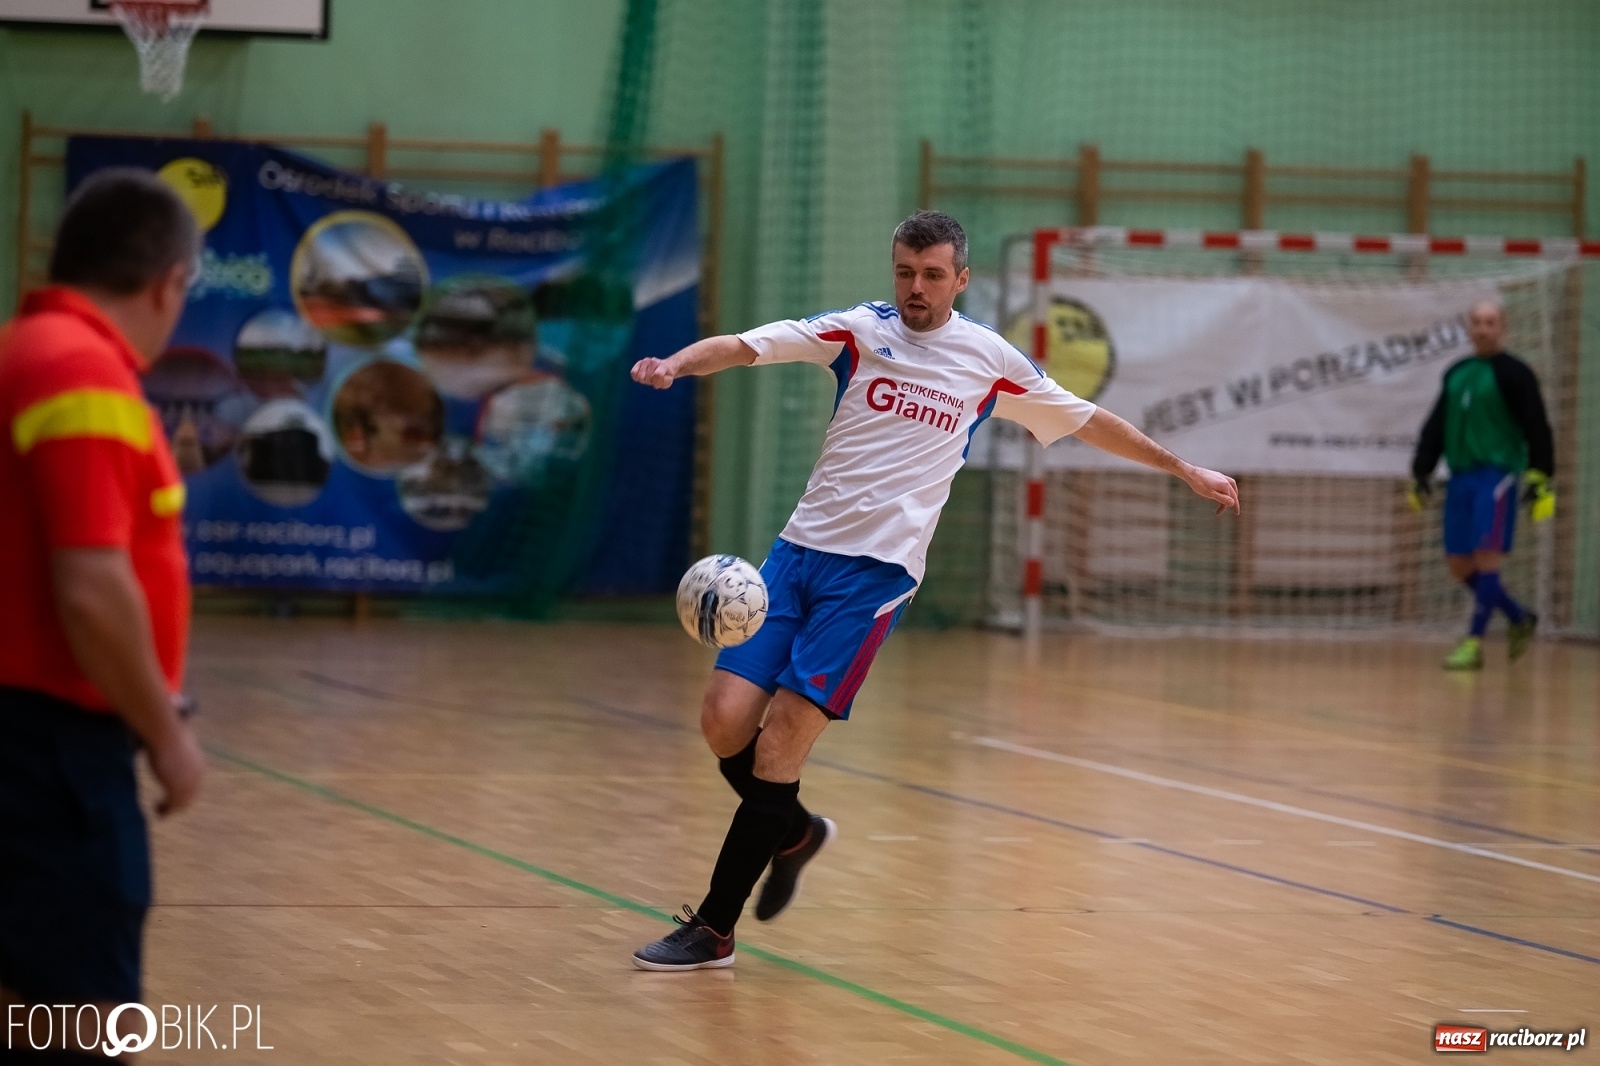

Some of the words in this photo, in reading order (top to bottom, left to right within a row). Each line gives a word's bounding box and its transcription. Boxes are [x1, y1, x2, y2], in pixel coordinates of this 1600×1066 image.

[866, 377, 962, 434] Gianni
[901, 382, 964, 411] CUKIERNIA
[1226, 373, 1262, 408] W
